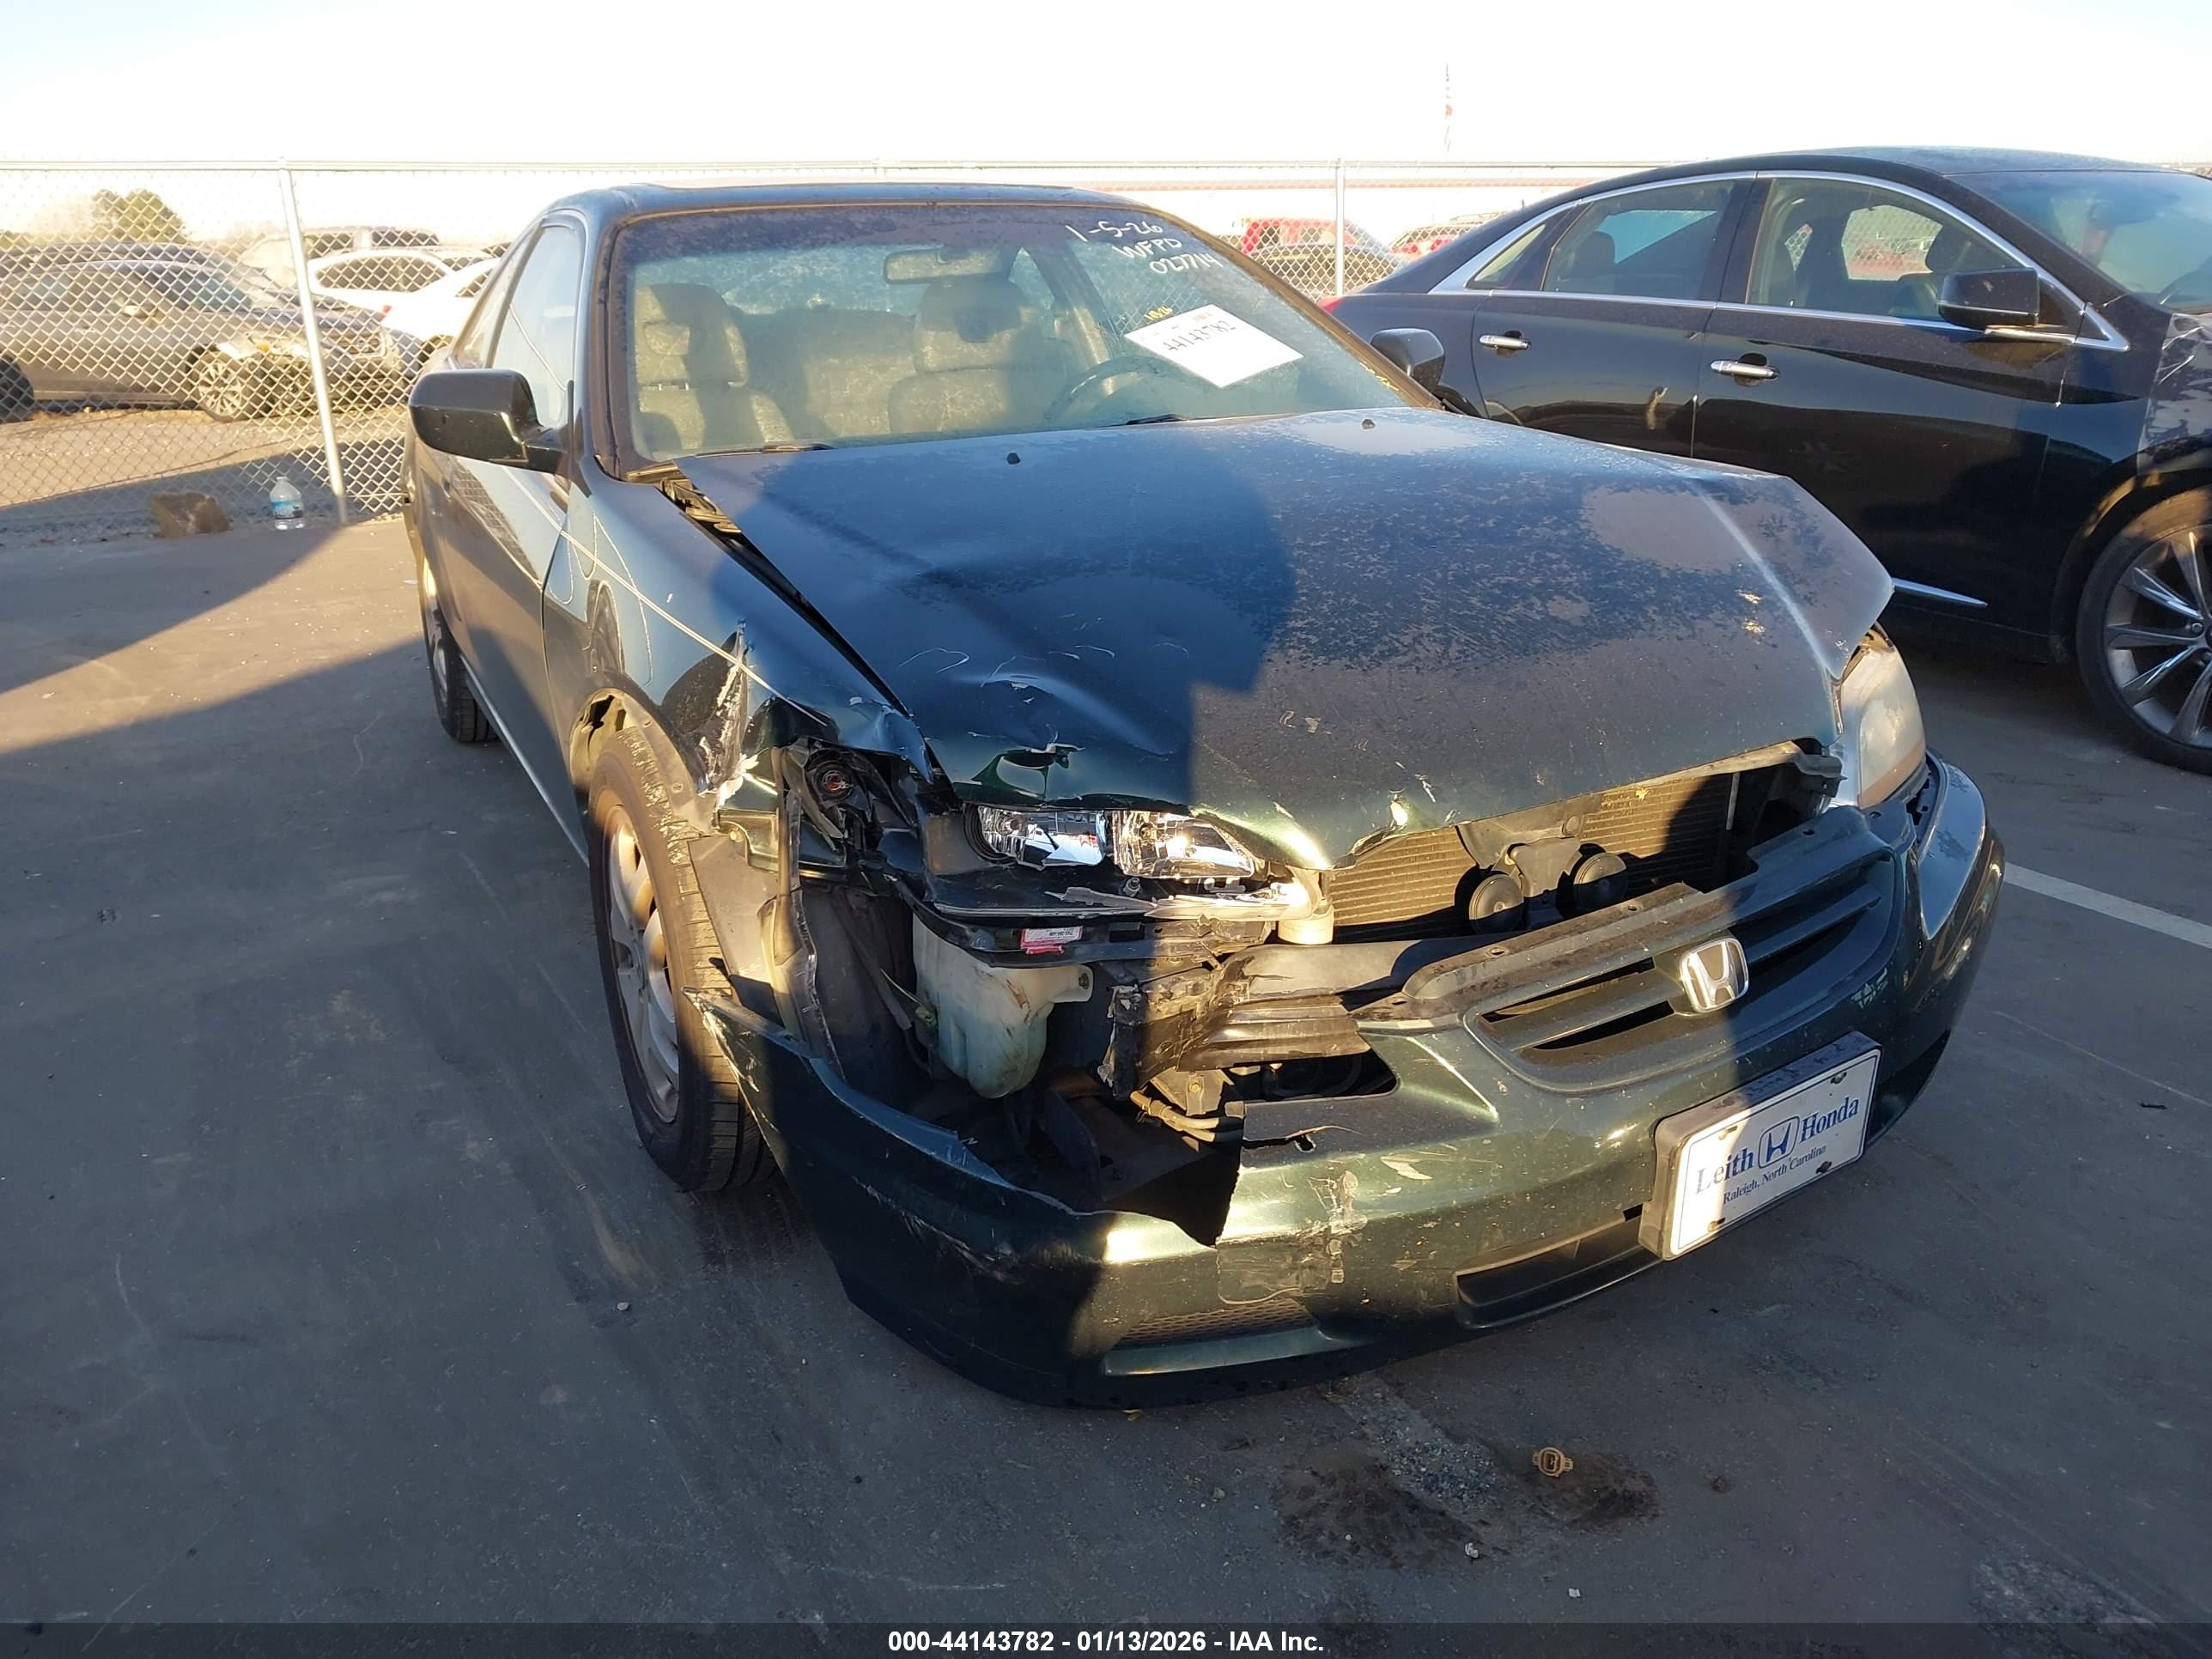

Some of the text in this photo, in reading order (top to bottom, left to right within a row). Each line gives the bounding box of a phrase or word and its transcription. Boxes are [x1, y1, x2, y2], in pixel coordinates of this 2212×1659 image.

[1065, 221, 1163, 242] 1-5-26
[1112, 238, 1182, 258] WFPD
[1149, 252, 1223, 274] 027714
[1696, 1147, 1754, 1194] Leith
[1800, 1097, 1859, 1144] Honda
[1723, 1145, 1826, 1205] Raleigh, North Carolina
